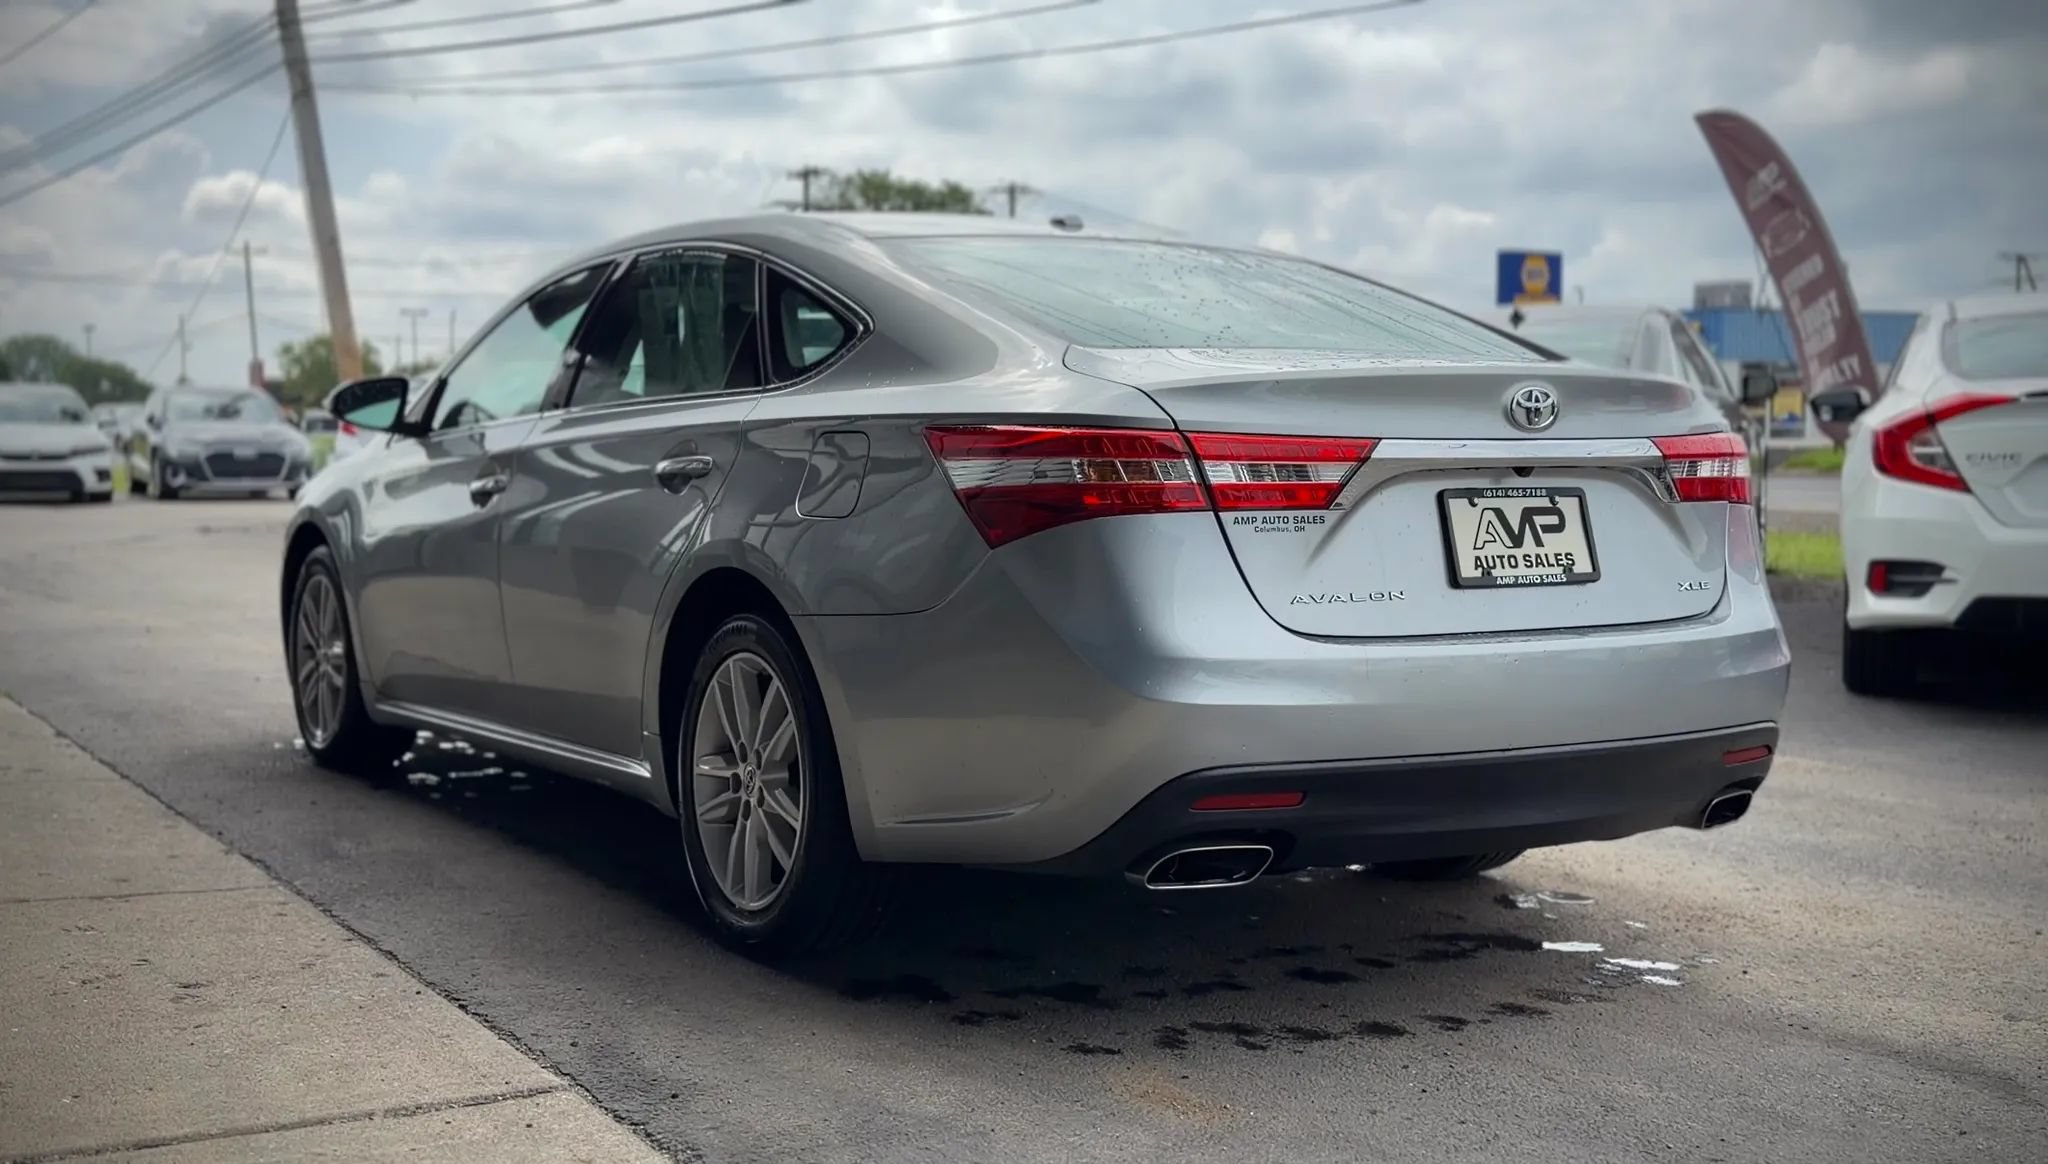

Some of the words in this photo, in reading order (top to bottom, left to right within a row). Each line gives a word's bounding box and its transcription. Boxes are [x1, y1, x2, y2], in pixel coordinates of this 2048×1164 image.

[1483, 488, 1505, 497] (614)
[1507, 488, 1547, 497] 465-7188
[1233, 516, 1258, 525] AMP
[1261, 516, 1290, 525] AUTO
[1292, 515, 1326, 525] SALES
[1254, 525, 1292, 533] Columbus,
[1294, 525, 1305, 533] OH
[1474, 554, 1519, 571] AUTO
[1523, 552, 1576, 569] SALES
[1496, 576, 1516, 585] AMP
[1517, 575, 1541, 584] AUTO
[1542, 574, 1567, 583] SALES
[1677, 581, 1711, 592] XLE
[1290, 590, 1406, 605] AVALON
